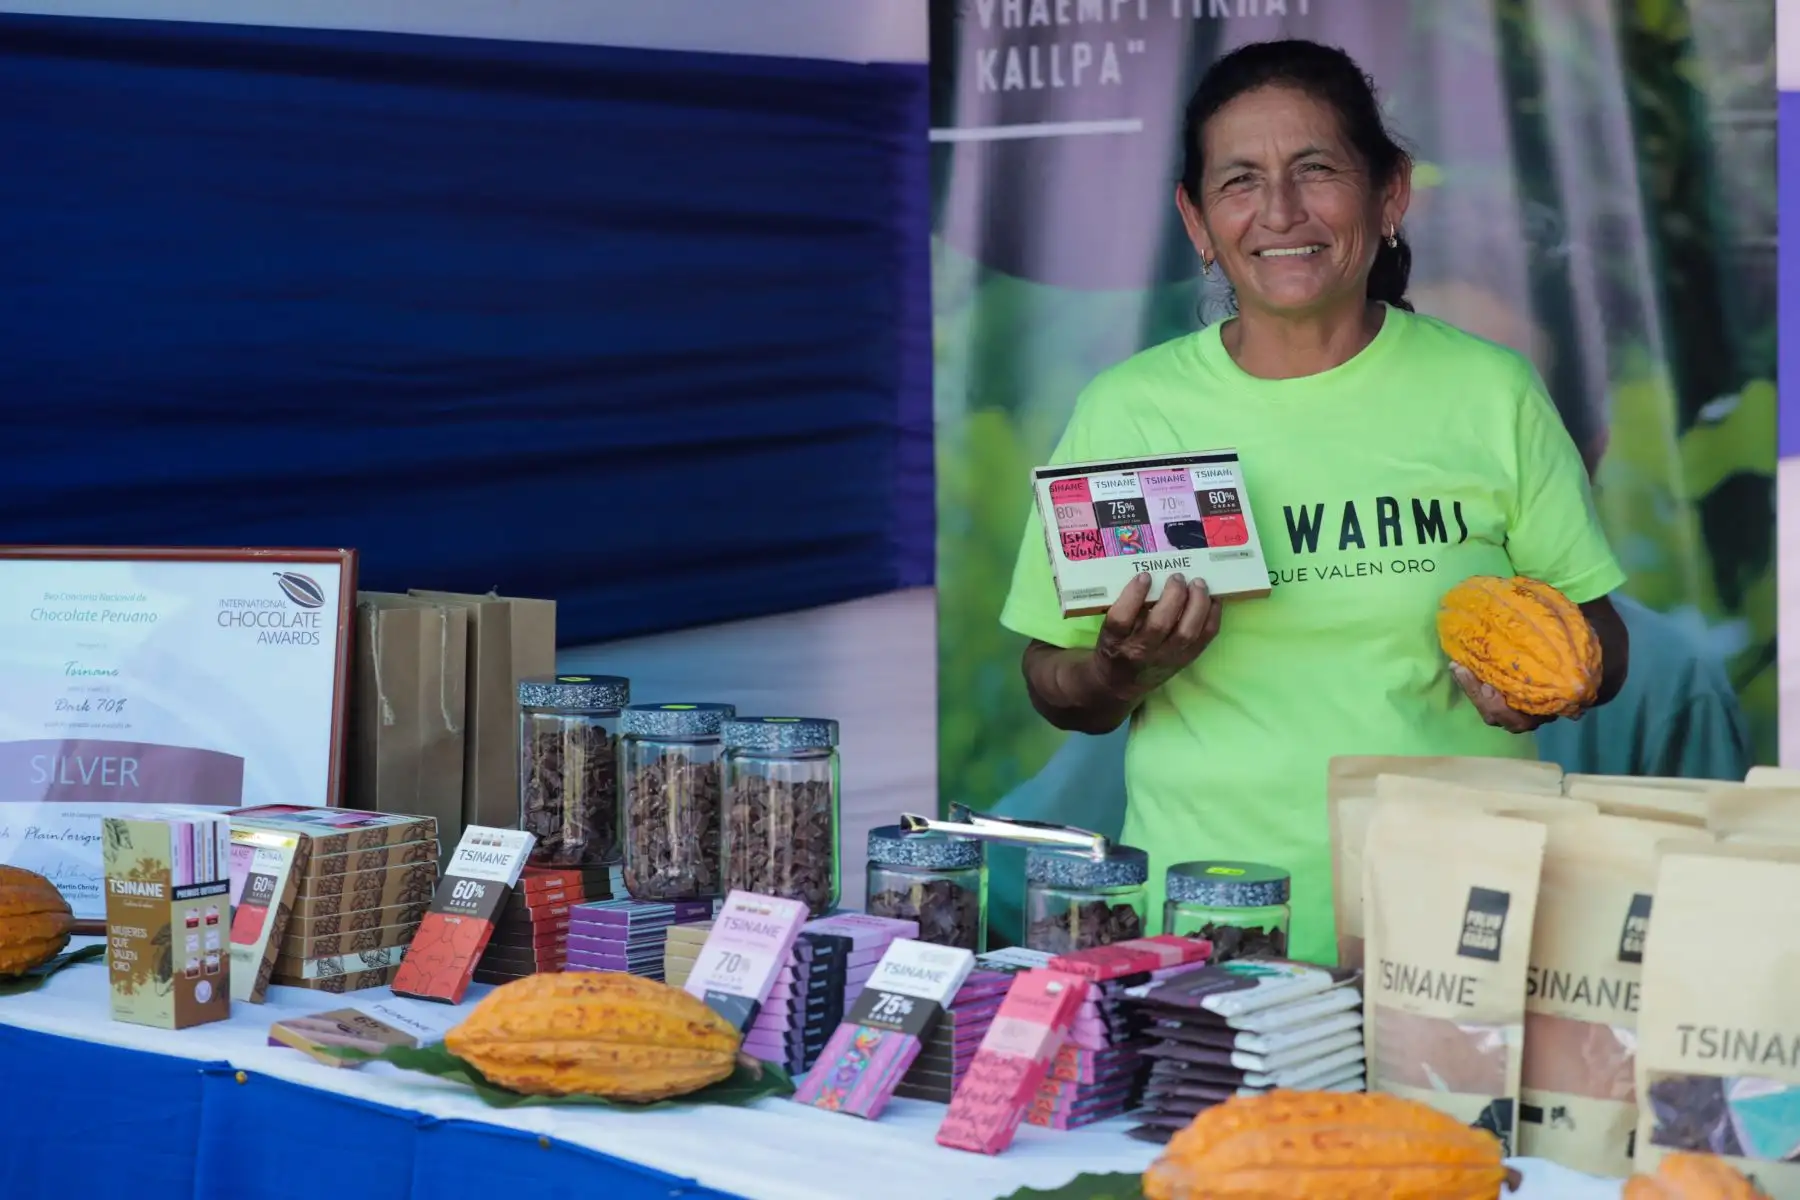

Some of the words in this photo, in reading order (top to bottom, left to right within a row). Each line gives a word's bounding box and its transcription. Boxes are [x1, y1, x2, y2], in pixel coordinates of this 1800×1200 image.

[1093, 478, 1137, 489] TSINANE
[1144, 474, 1187, 485] TSINANE
[1208, 490, 1235, 504] 60%
[1107, 500, 1135, 515] 75%
[1283, 496, 1468, 554] WARMI
[1132, 556, 1191, 572] TSINANE
[1268, 568, 1308, 586] QUE
[1315, 561, 1384, 580] VALEN
[1390, 558, 1436, 574] ORO
[218, 599, 287, 609] INTERNATIONAL
[30, 607, 98, 622] Chocolate
[100, 608, 158, 623] Peruano
[217, 610, 322, 629] CHOCOLATE
[256, 631, 320, 646] AWARDS
[96, 697, 128, 714] 70%
[30, 754, 140, 788] SILVER
[459, 849, 513, 866] TSINANE
[56, 883, 77, 891] Martin
[77, 883, 99, 892] Christy
[109, 879, 165, 898] TSINANE
[253, 876, 275, 892] 60%
[451, 880, 486, 900] 60%
[110, 925, 148, 939] MUJERES
[723, 916, 785, 938] TSINANE
[111, 937, 129, 949] QUE
[111, 948, 139, 961] VALEN
[112, 960, 131, 972] ORO
[884, 961, 950, 984] TSINANE
[871, 992, 914, 1015] 75%
